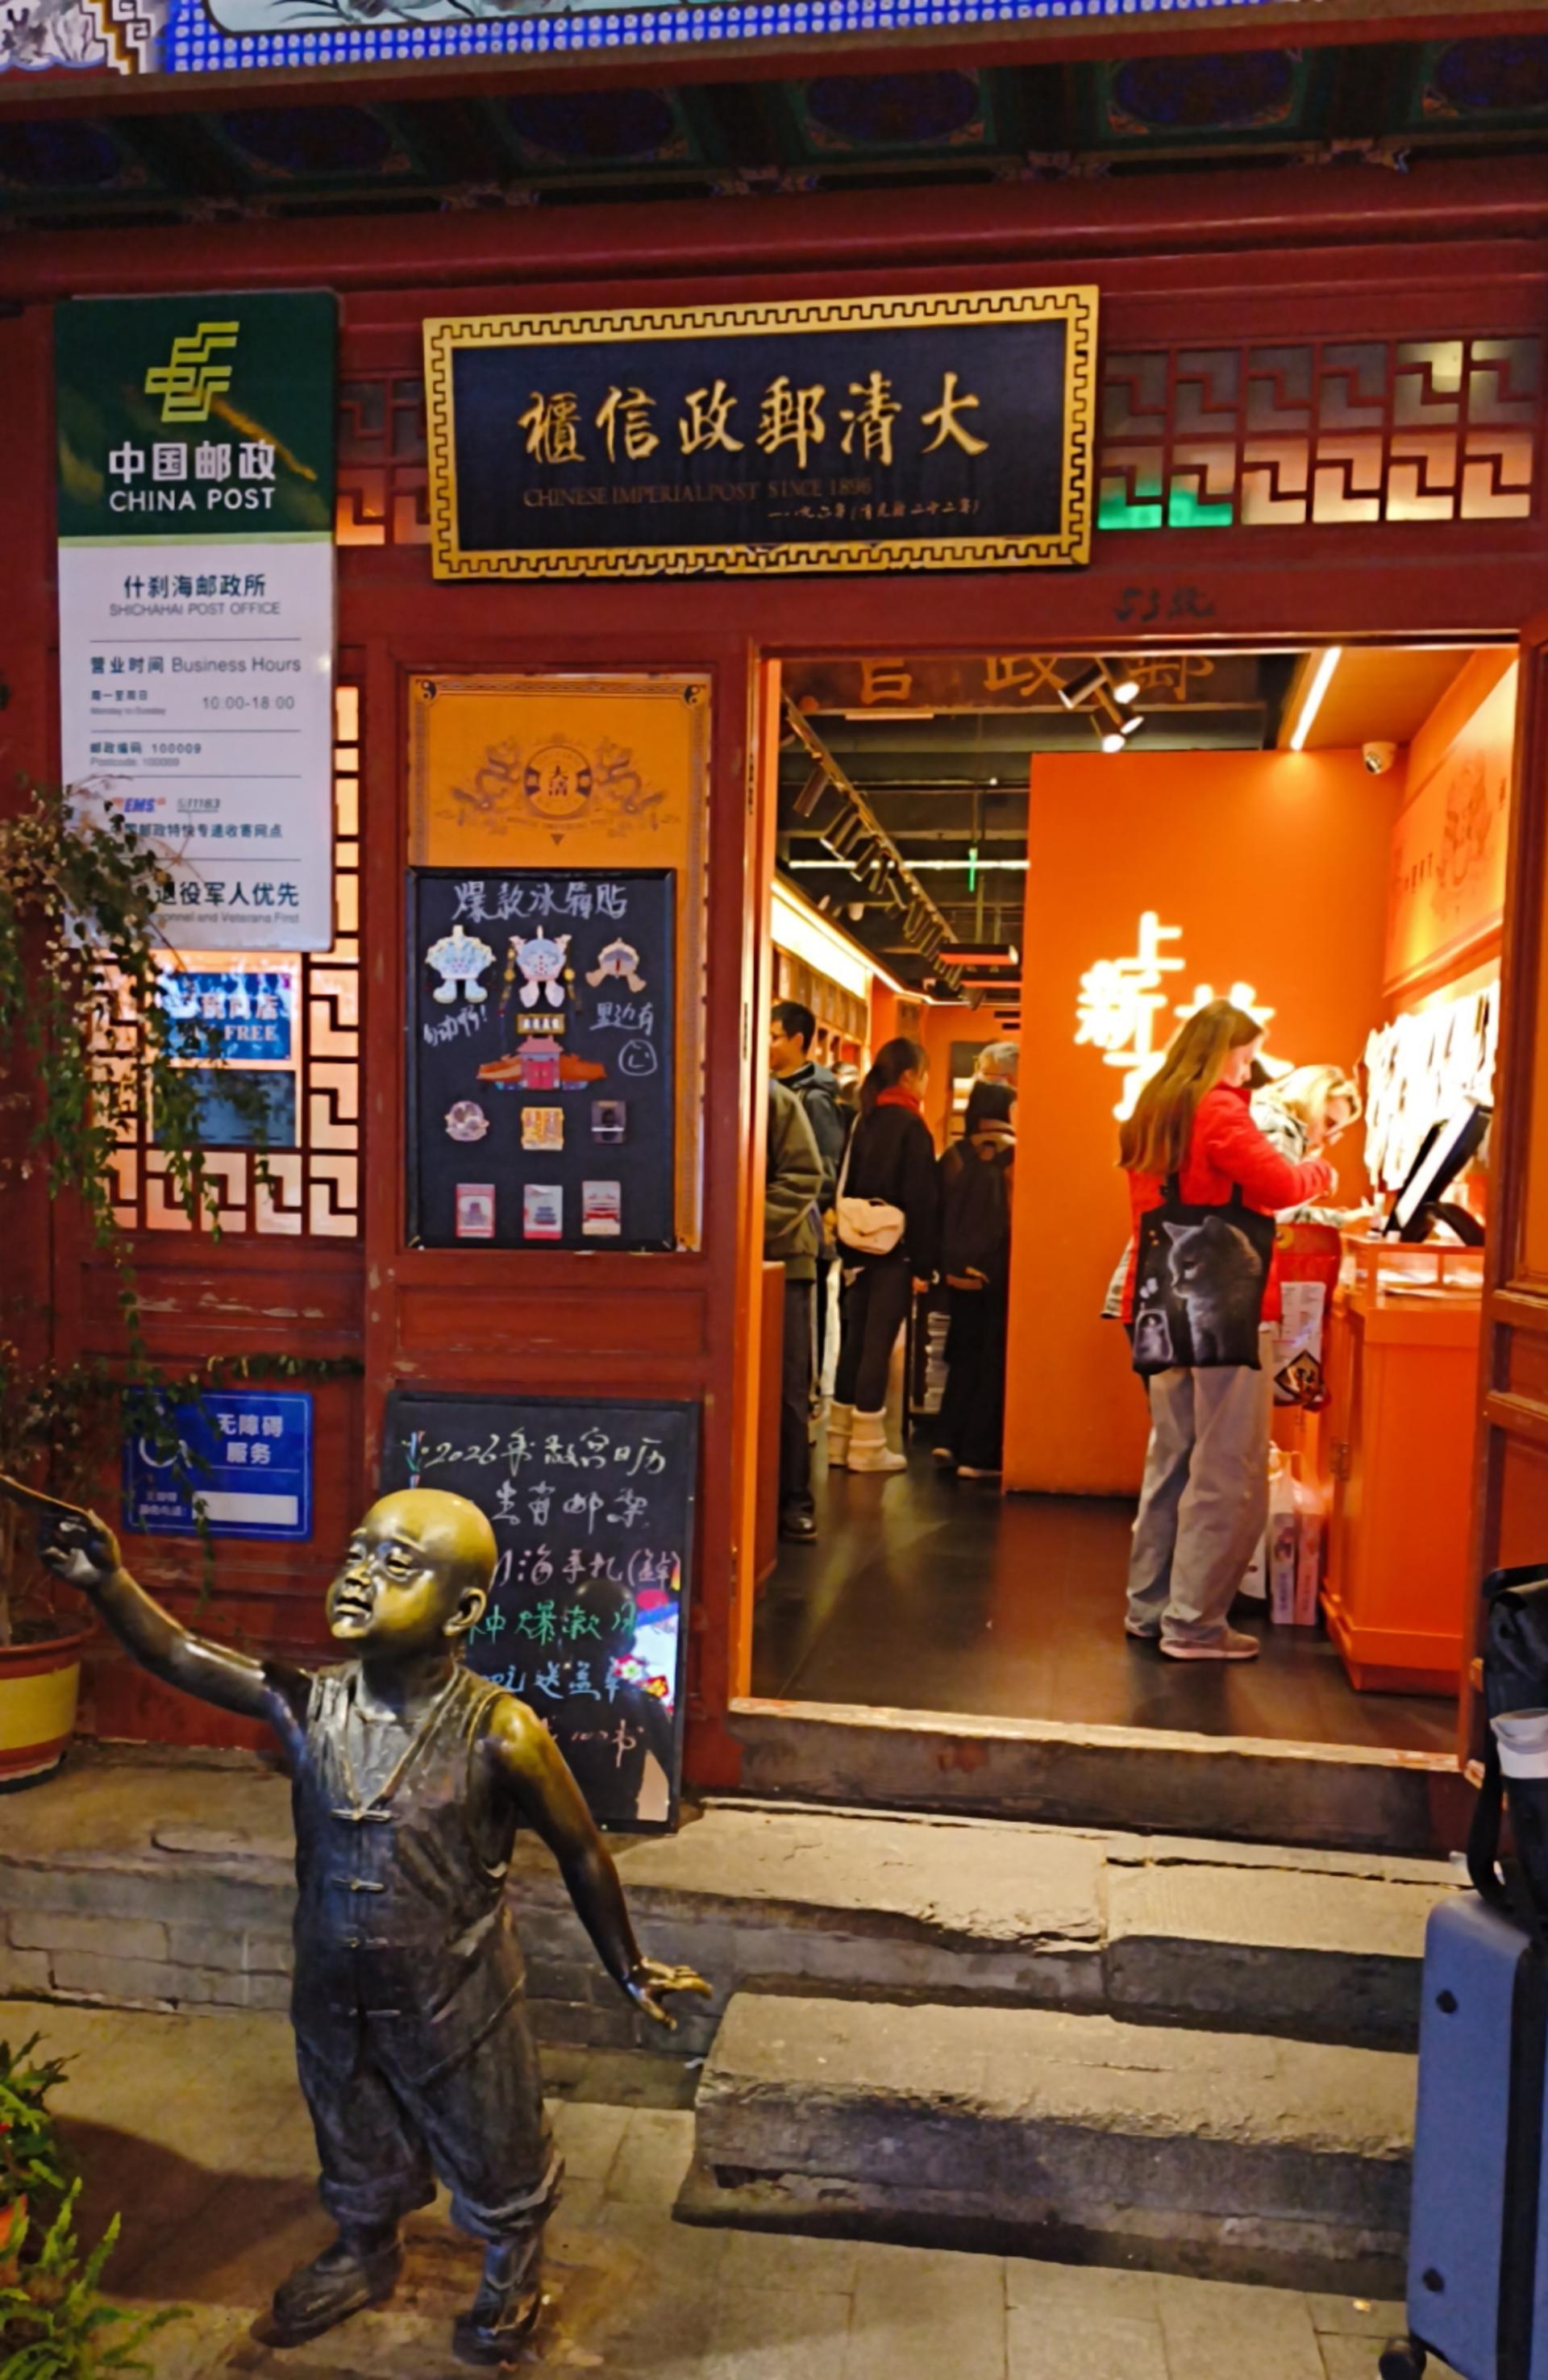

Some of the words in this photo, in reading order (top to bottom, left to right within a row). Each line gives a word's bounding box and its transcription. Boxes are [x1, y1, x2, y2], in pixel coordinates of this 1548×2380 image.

[110, 440, 275, 483] 中国邮政
[110, 490, 196, 511] CHINA
[207, 488, 275, 510] POST
[523, 487, 608, 507] CHINESE
[768, 479, 822, 497] SINCE
[124, 574, 265, 599] 什刹海邮政所
[110, 603, 182, 617] SHICHAHAI
[189, 602, 225, 615] POST
[231, 601, 281, 615] OFFICE
[90, 656, 164, 674] 营业时间
[172, 657, 246, 672] Business
[252, 656, 302, 672] Hours
[202, 696, 295, 709] 10:00-18:00
[152, 743, 202, 754] 100009
[124, 798, 155, 813] EMS
[112, 823, 282, 838] 国邮政特快专递收寄网点
[224, 1025, 277, 1041] FREE
[216, 1413, 283, 1438] 无障碍
[226, 1442, 271, 1465] 服务
